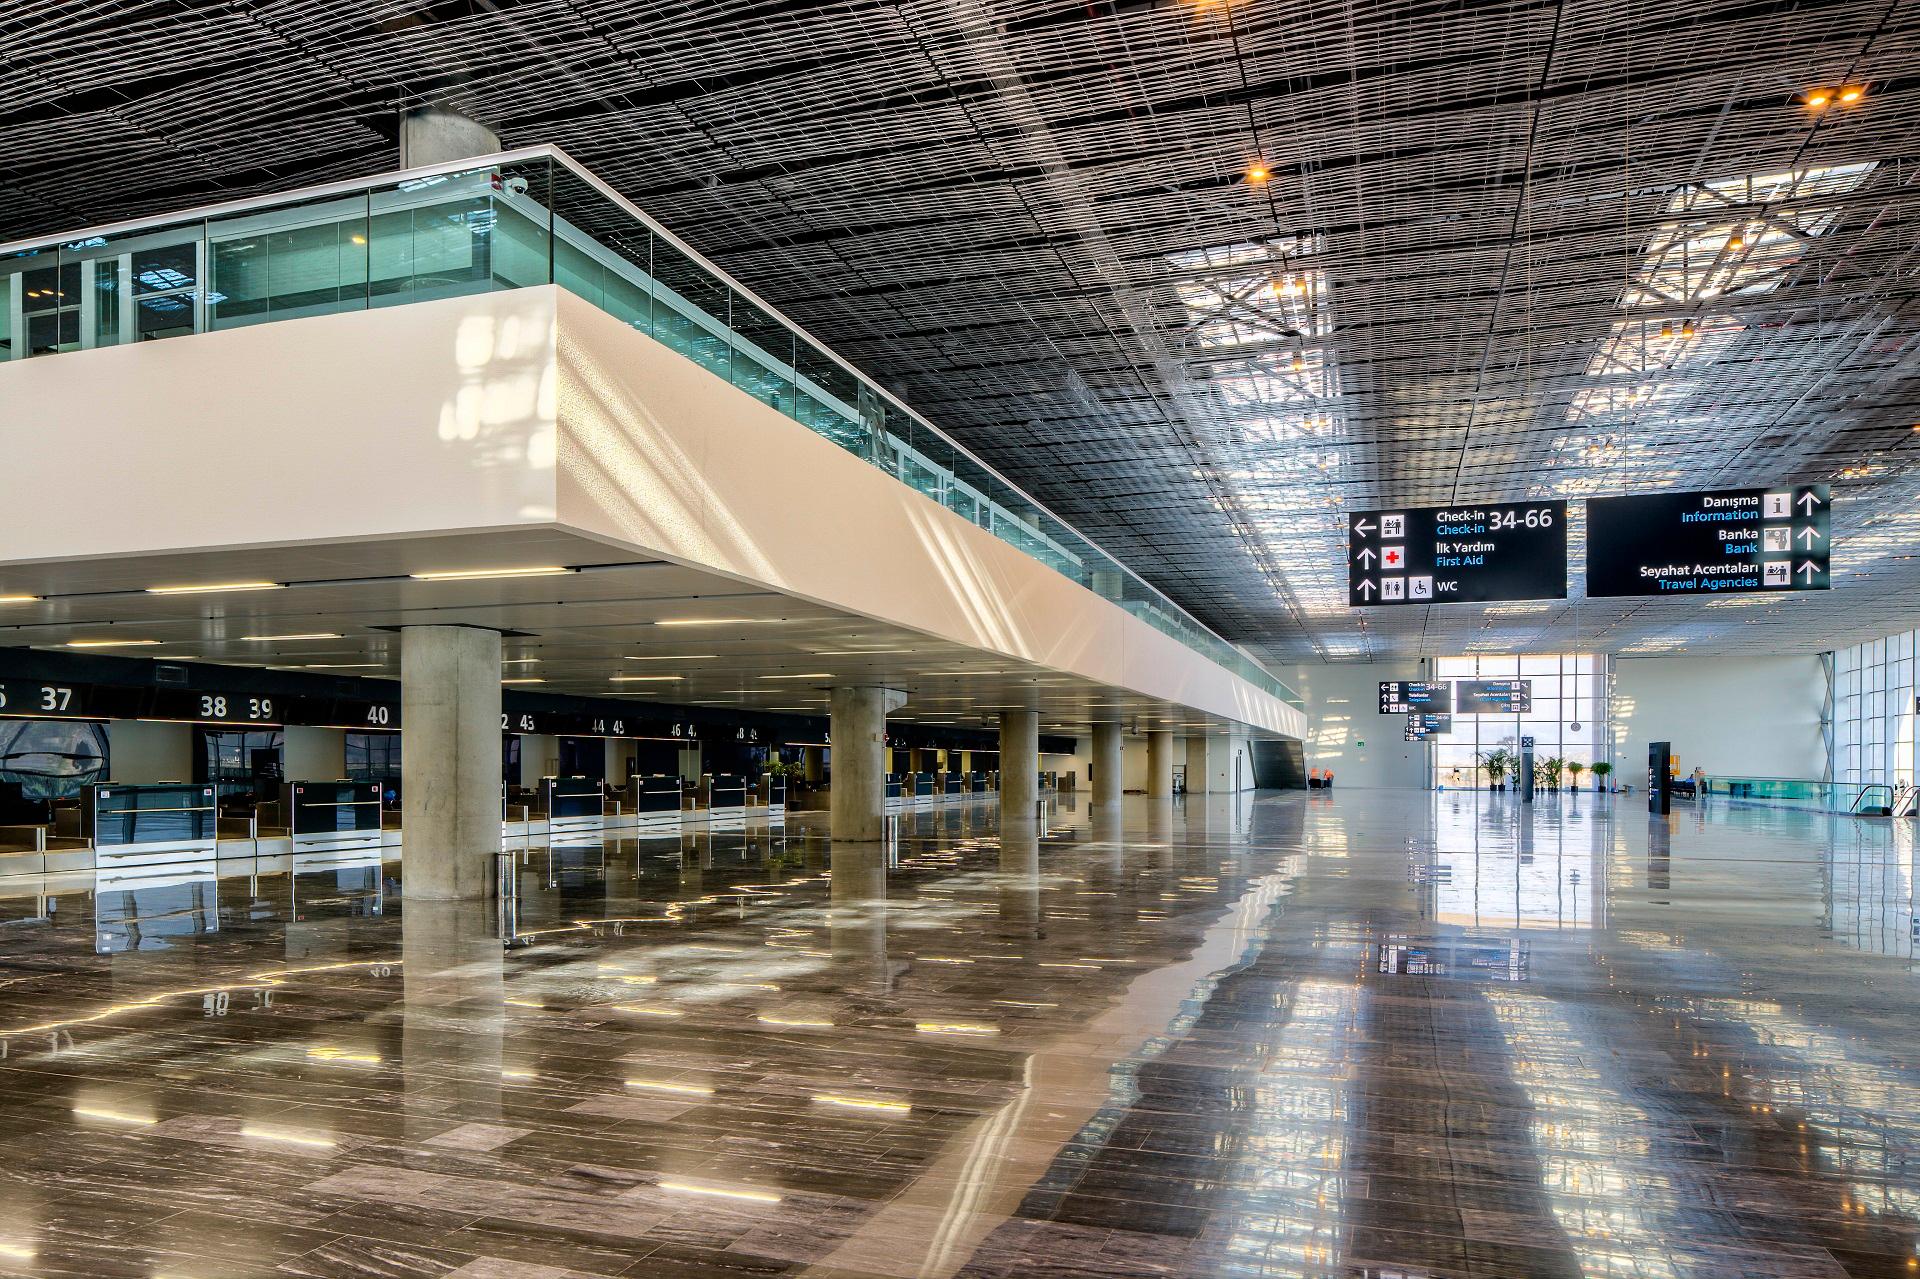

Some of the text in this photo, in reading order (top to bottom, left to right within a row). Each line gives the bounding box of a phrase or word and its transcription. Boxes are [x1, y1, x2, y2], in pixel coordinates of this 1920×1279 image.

[1703, 496, 1759, 509] Danışma
[1436, 508, 1553, 530] Check-in 34-66
[1682, 510, 1759, 523] Information
[1436, 523, 1485, 535] Check-in
[1718, 528, 1759, 541] Banka
[1452, 541, 1495, 553] Yardım
[1725, 543, 1758, 554] Bank
[1436, 555, 1484, 567] First Aid
[1640, 563, 1759, 578] Seyahat Acentaları
[1437, 581, 1458, 592] WC
[1659, 577, 1758, 590] Travel Agencies
[41, 686, 72, 711] 37
[201, 695, 227, 717] 38
[249, 698, 272, 719] 39
[367, 705, 389, 725] 40
[520, 714, 535, 731] 43
